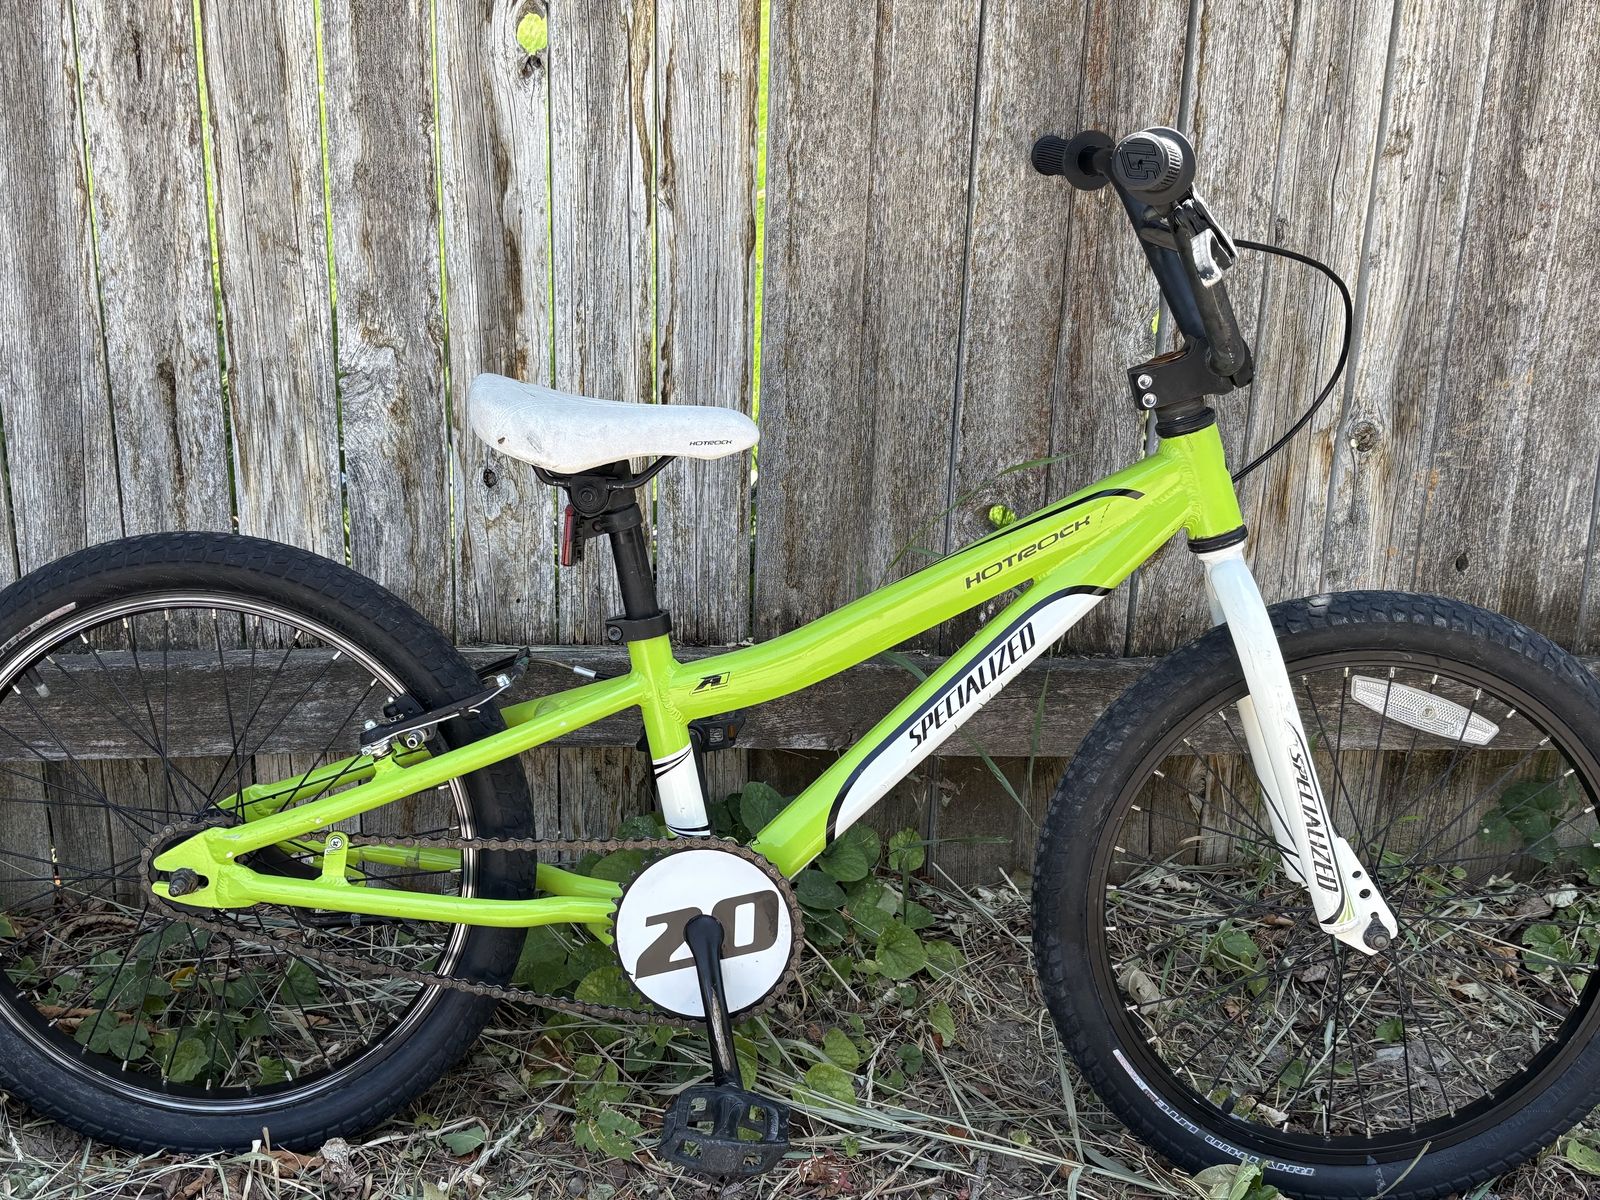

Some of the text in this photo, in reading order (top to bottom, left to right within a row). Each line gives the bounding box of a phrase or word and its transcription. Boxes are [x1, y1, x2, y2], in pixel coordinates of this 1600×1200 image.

[689, 439, 733, 447] HOTROCK
[965, 516, 1091, 590] HOTROCK
[909, 621, 1036, 752] SPECIALIZED
[1290, 747, 1339, 893] SPECIALIZED
[635, 889, 779, 979] 20
